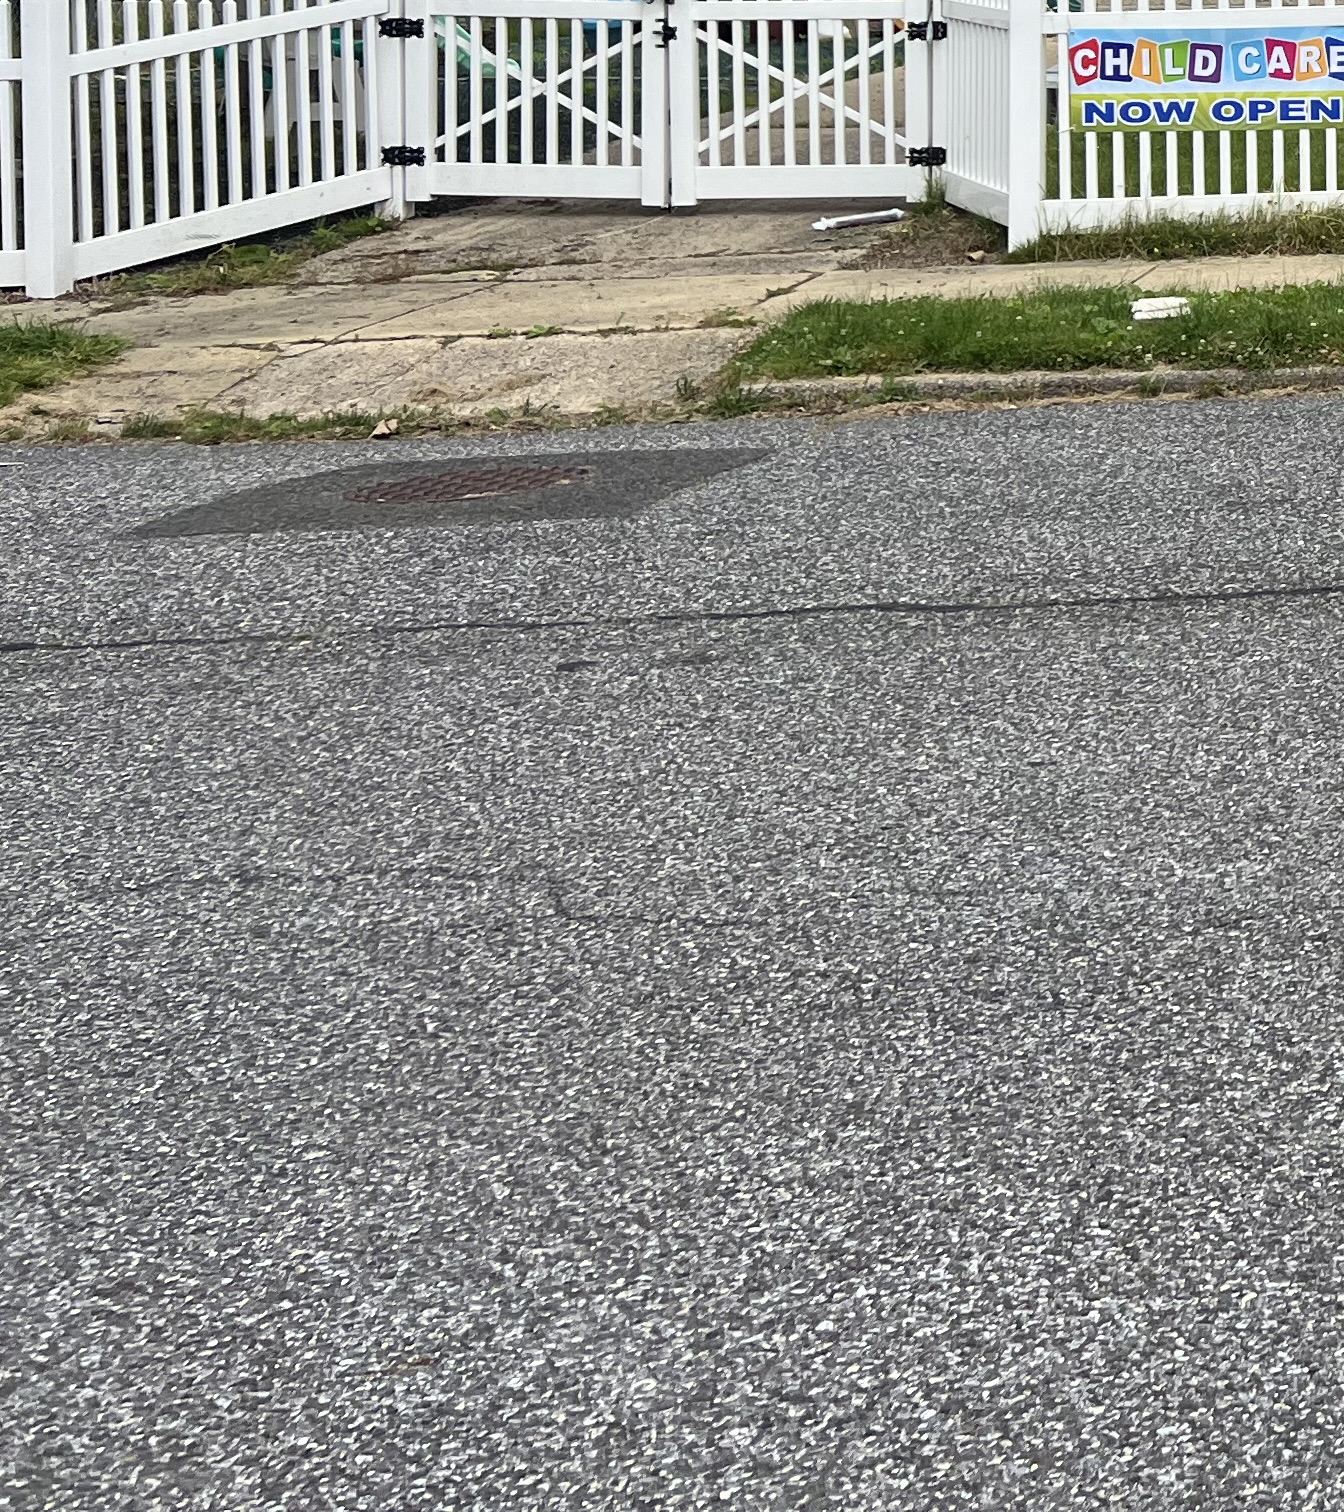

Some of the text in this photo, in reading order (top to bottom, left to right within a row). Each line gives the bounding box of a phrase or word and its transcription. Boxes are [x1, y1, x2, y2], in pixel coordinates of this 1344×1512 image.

[1073, 45, 1217, 77] CHILD
[1084, 98, 1341, 124] NOW OPEN
